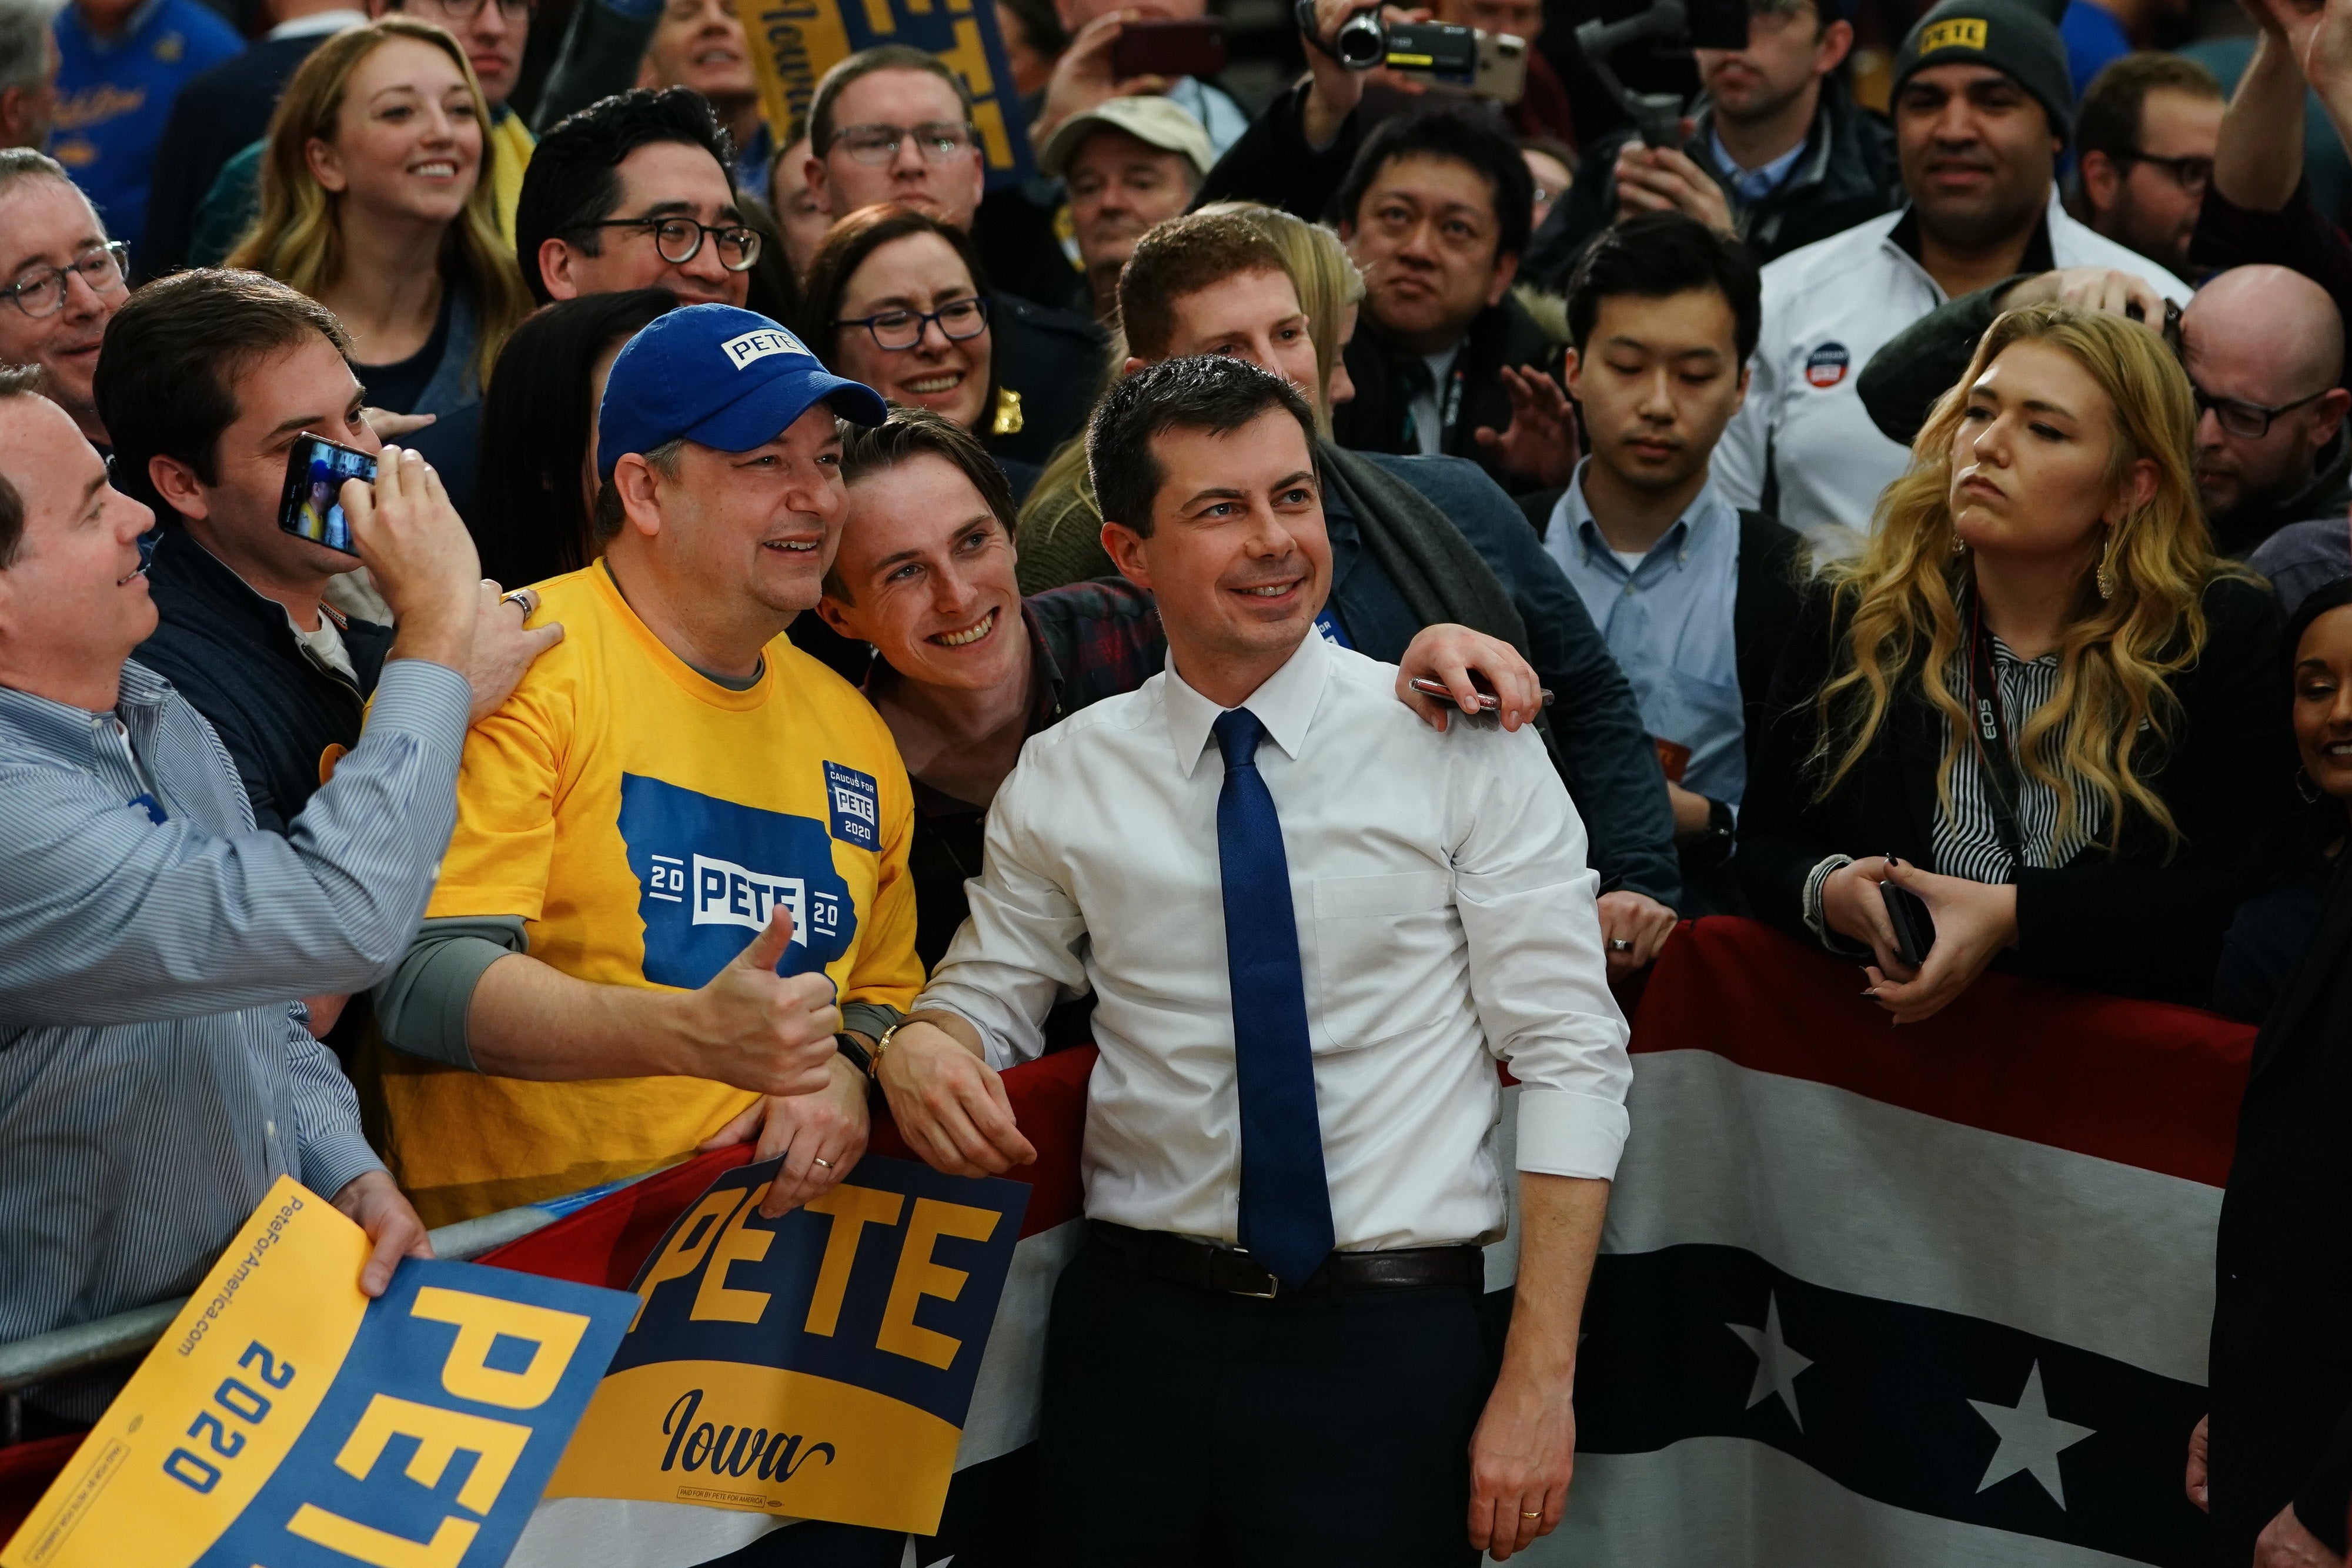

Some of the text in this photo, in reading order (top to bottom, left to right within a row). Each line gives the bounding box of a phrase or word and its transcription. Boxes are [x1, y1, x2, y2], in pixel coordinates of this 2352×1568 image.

[731, 333, 798, 360] PETE
[1318, 621, 1332, 634] OR
[1979, 698, 1997, 740] EOS
[830, 771, 874, 794] CAUCUS FOR
[838, 791, 872, 819] PETE
[845, 820, 870, 840] 2020
[651, 865, 684, 892] 20
[814, 902, 838, 927] 20
[178, 1195, 303, 1356] PeteForAmerica.com
[627, 1181, 1003, 1371] PETE
[162, 1339, 296, 1494] 2020
[249, 1286, 591, 1568] PET
[660, 1389, 836, 1483] Iowa
[739, 1496, 763, 1505] AMERICA
